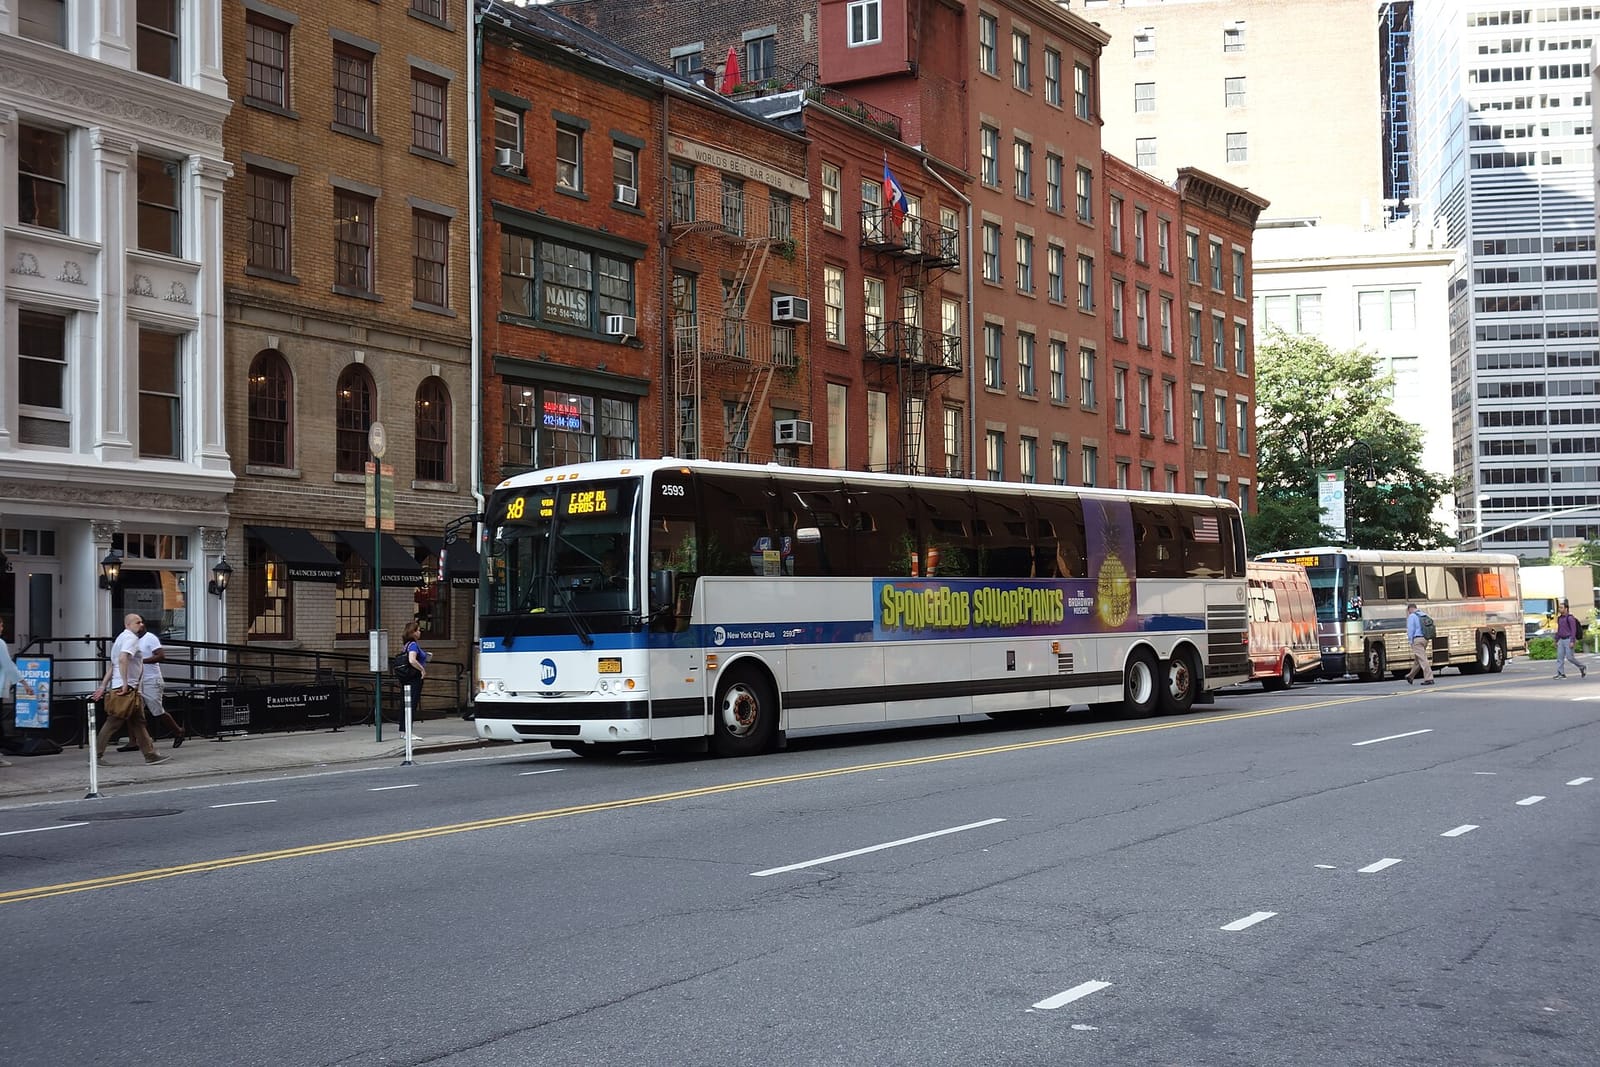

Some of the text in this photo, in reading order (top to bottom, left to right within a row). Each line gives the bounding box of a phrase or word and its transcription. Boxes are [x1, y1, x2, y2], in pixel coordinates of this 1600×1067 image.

[750, 167, 763, 179] BAR
[546, 286, 586, 310] NAILS
[546, 306, 557, 315] 212
[661, 484, 685, 497] 2593
[570, 493, 577, 504] F
[578, 491, 594, 503] CAP
[596, 490, 606, 501] BL
[595, 501, 607, 511] LA
[1077, 590, 1085, 598] THE
[882, 584, 1064, 628] SPONGEBOB SQUAREPANTS
[740, 631, 752, 639] York
[752, 631, 764, 639] City
[764, 630, 776, 638] Bus
[266, 696, 301, 704] FRAUNCES
